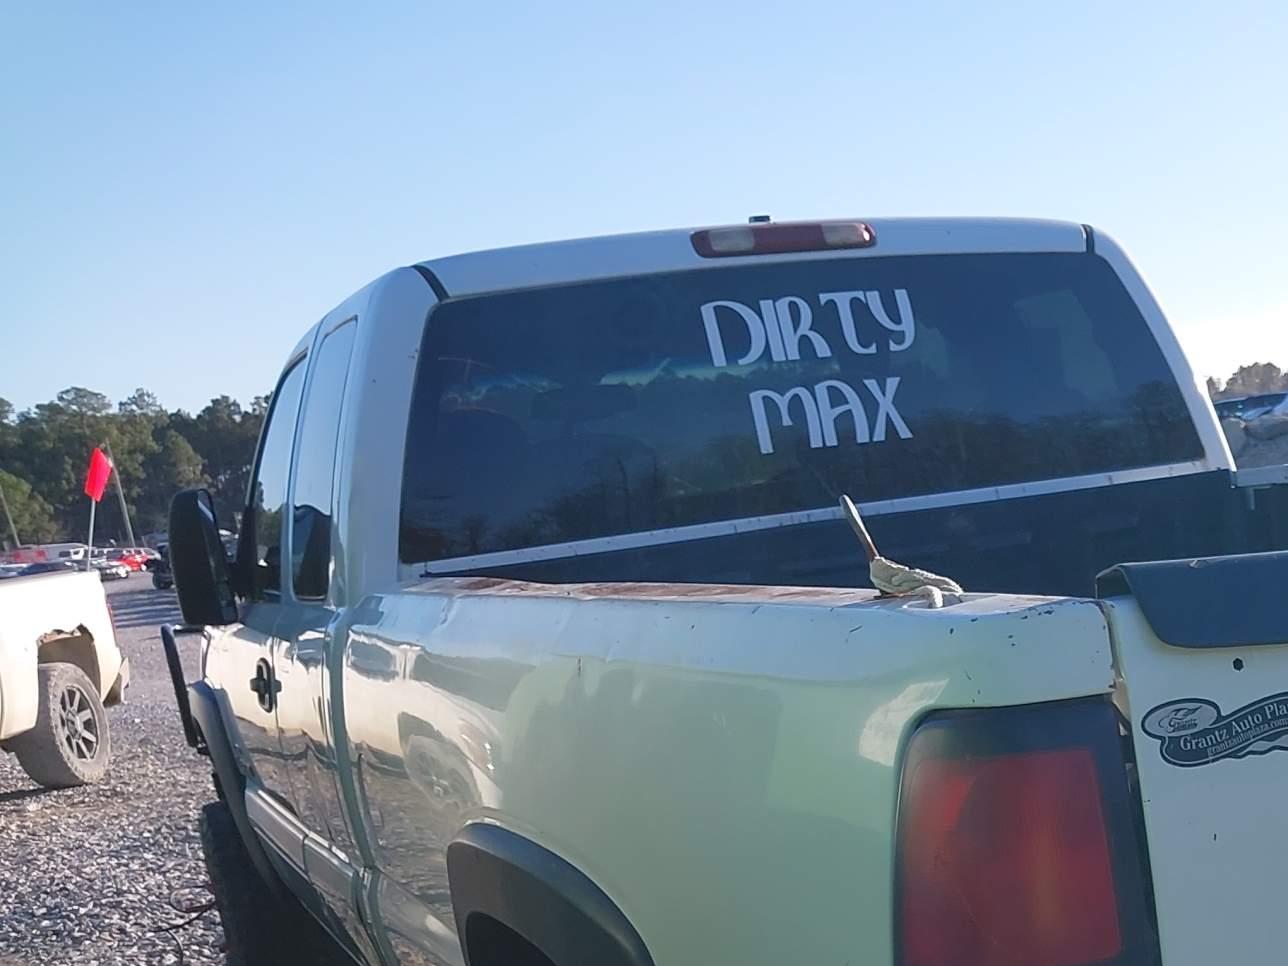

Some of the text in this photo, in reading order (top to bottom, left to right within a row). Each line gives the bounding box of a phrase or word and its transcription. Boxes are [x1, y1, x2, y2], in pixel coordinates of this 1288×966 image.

[700, 288, 917, 368] DIRTY
[748, 376, 914, 456] MAX
[1180, 728, 1230, 752] Grantz
[1231, 713, 1263, 736] Auto
